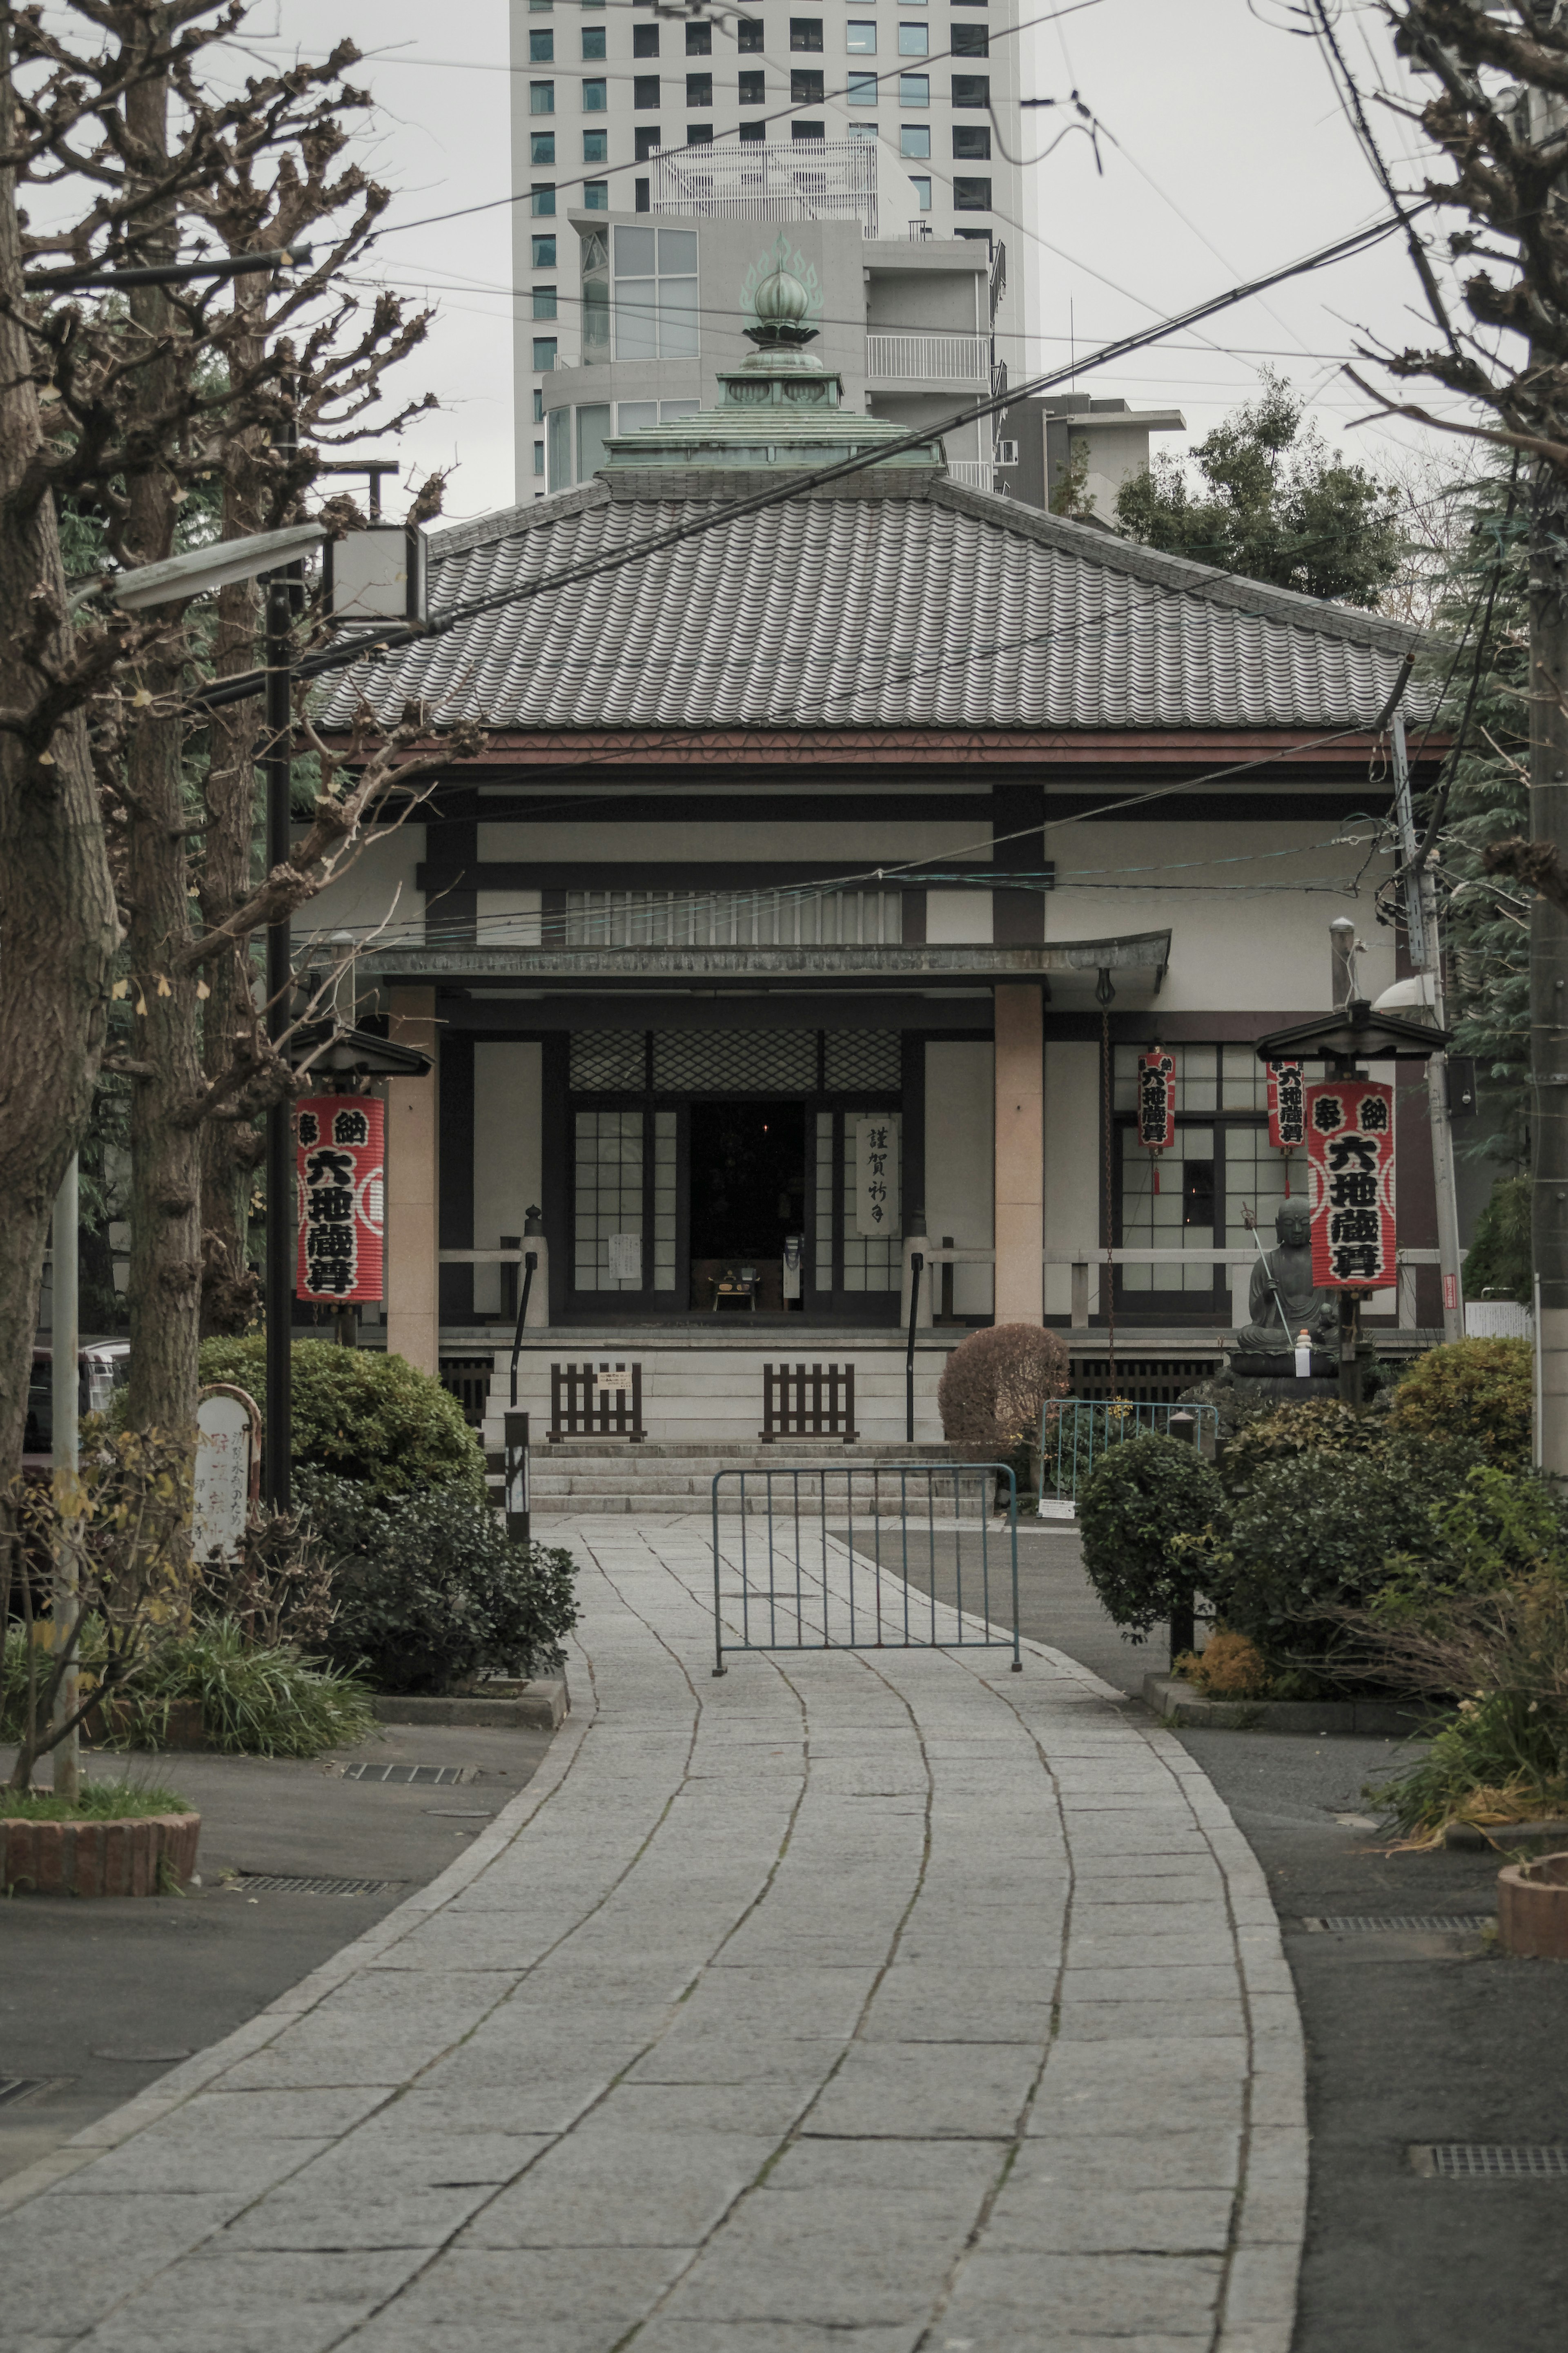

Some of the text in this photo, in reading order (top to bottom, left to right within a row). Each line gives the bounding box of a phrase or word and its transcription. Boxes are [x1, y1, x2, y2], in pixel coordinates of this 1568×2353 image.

[1143, 1067, 1166, 1142] 六地蔵尊
[1279, 1068, 1303, 1142] 六地蔵尊
[1315, 1099, 1387, 1131] 奉納
[867, 1126, 888, 1222] 謹賀新年
[1329, 1136, 1381, 1279] 六地蔵尊
[307, 1151, 354, 1293] 六地蔵尊
